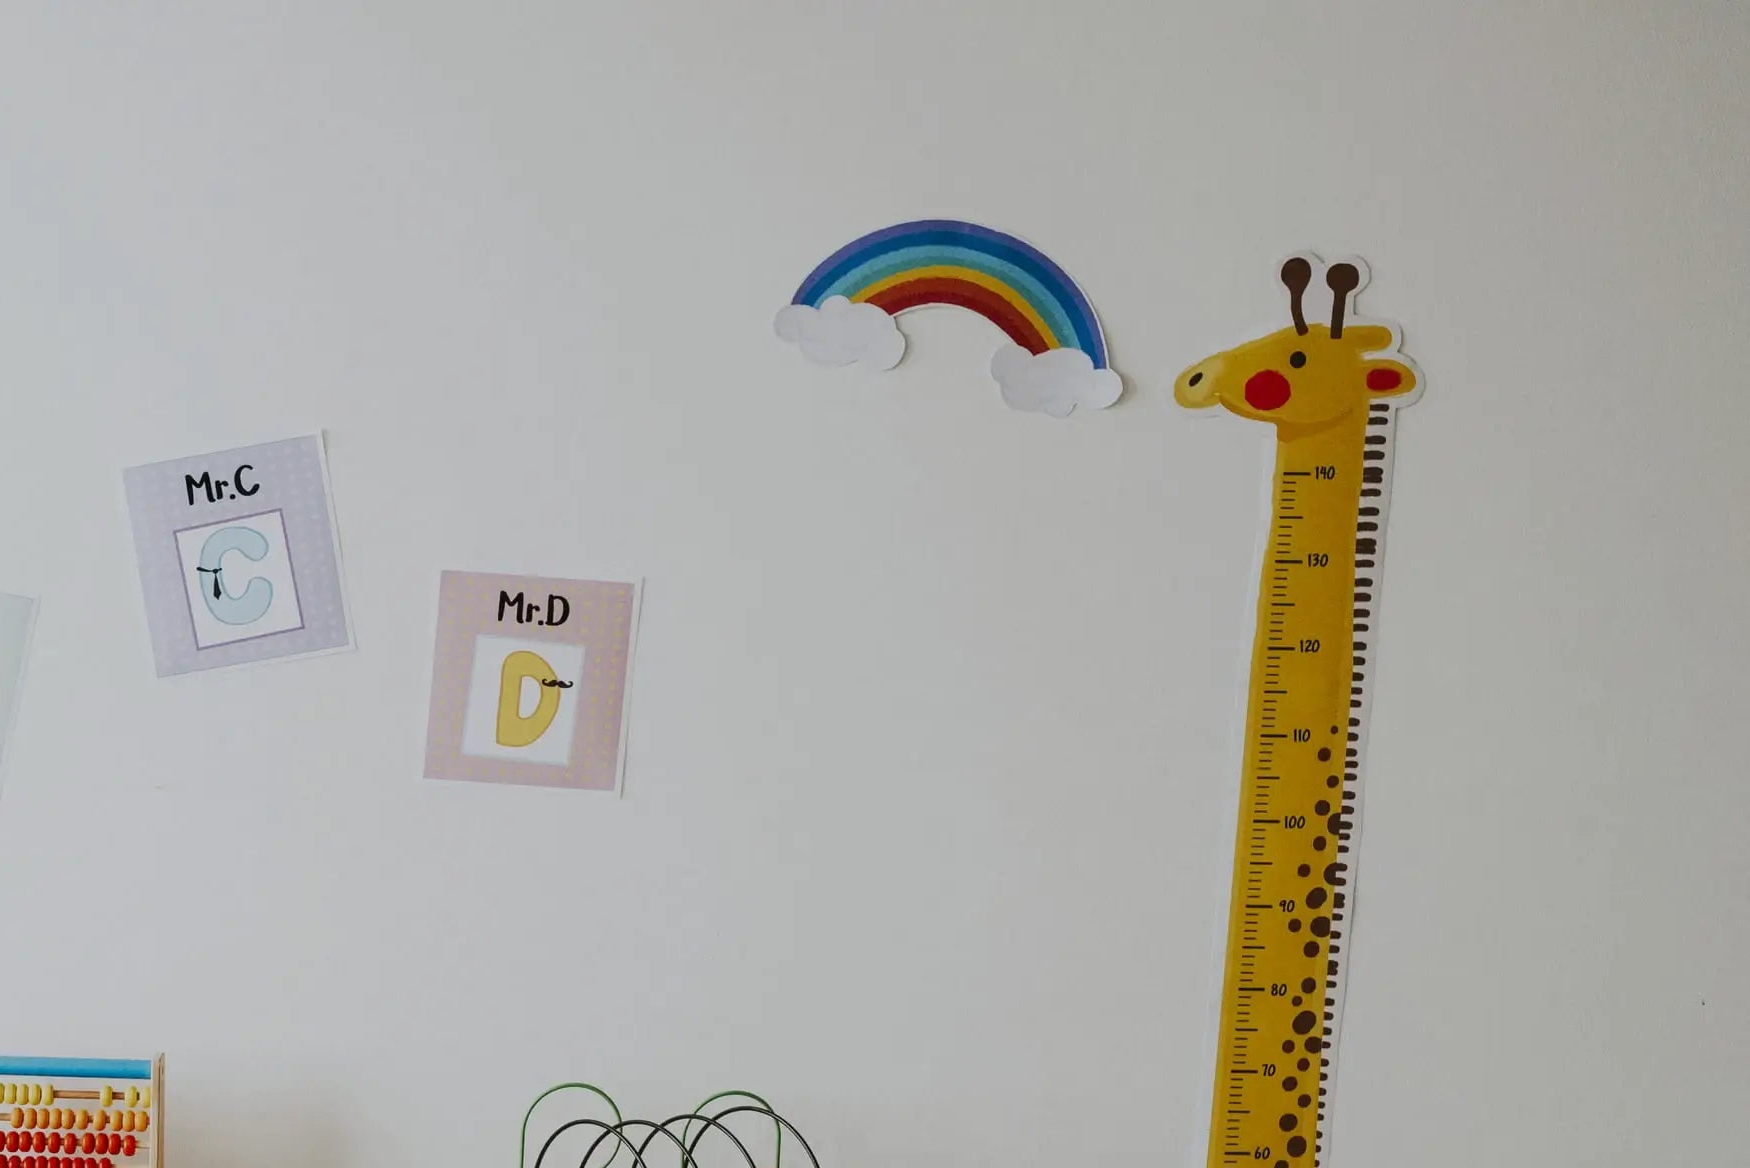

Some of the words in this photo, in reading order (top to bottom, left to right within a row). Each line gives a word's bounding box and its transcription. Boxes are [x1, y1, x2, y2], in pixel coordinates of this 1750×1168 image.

[1315, 465, 1336, 481] 140
[184, 464, 261, 505] Mr.C
[1307, 553, 1329, 568] 130
[198, 525, 274, 626] C
[497, 590, 570, 627] Mr.D
[1300, 639, 1321, 653] 120
[495, 649, 562, 748] D
[1293, 729, 1311, 743] 110
[1284, 815, 1306, 830] 100
[1279, 900, 1295, 913] 90
[1270, 983, 1287, 997] 80
[1261, 1064, 1276, 1077] 70
[1254, 1147, 1271, 1160] 60
